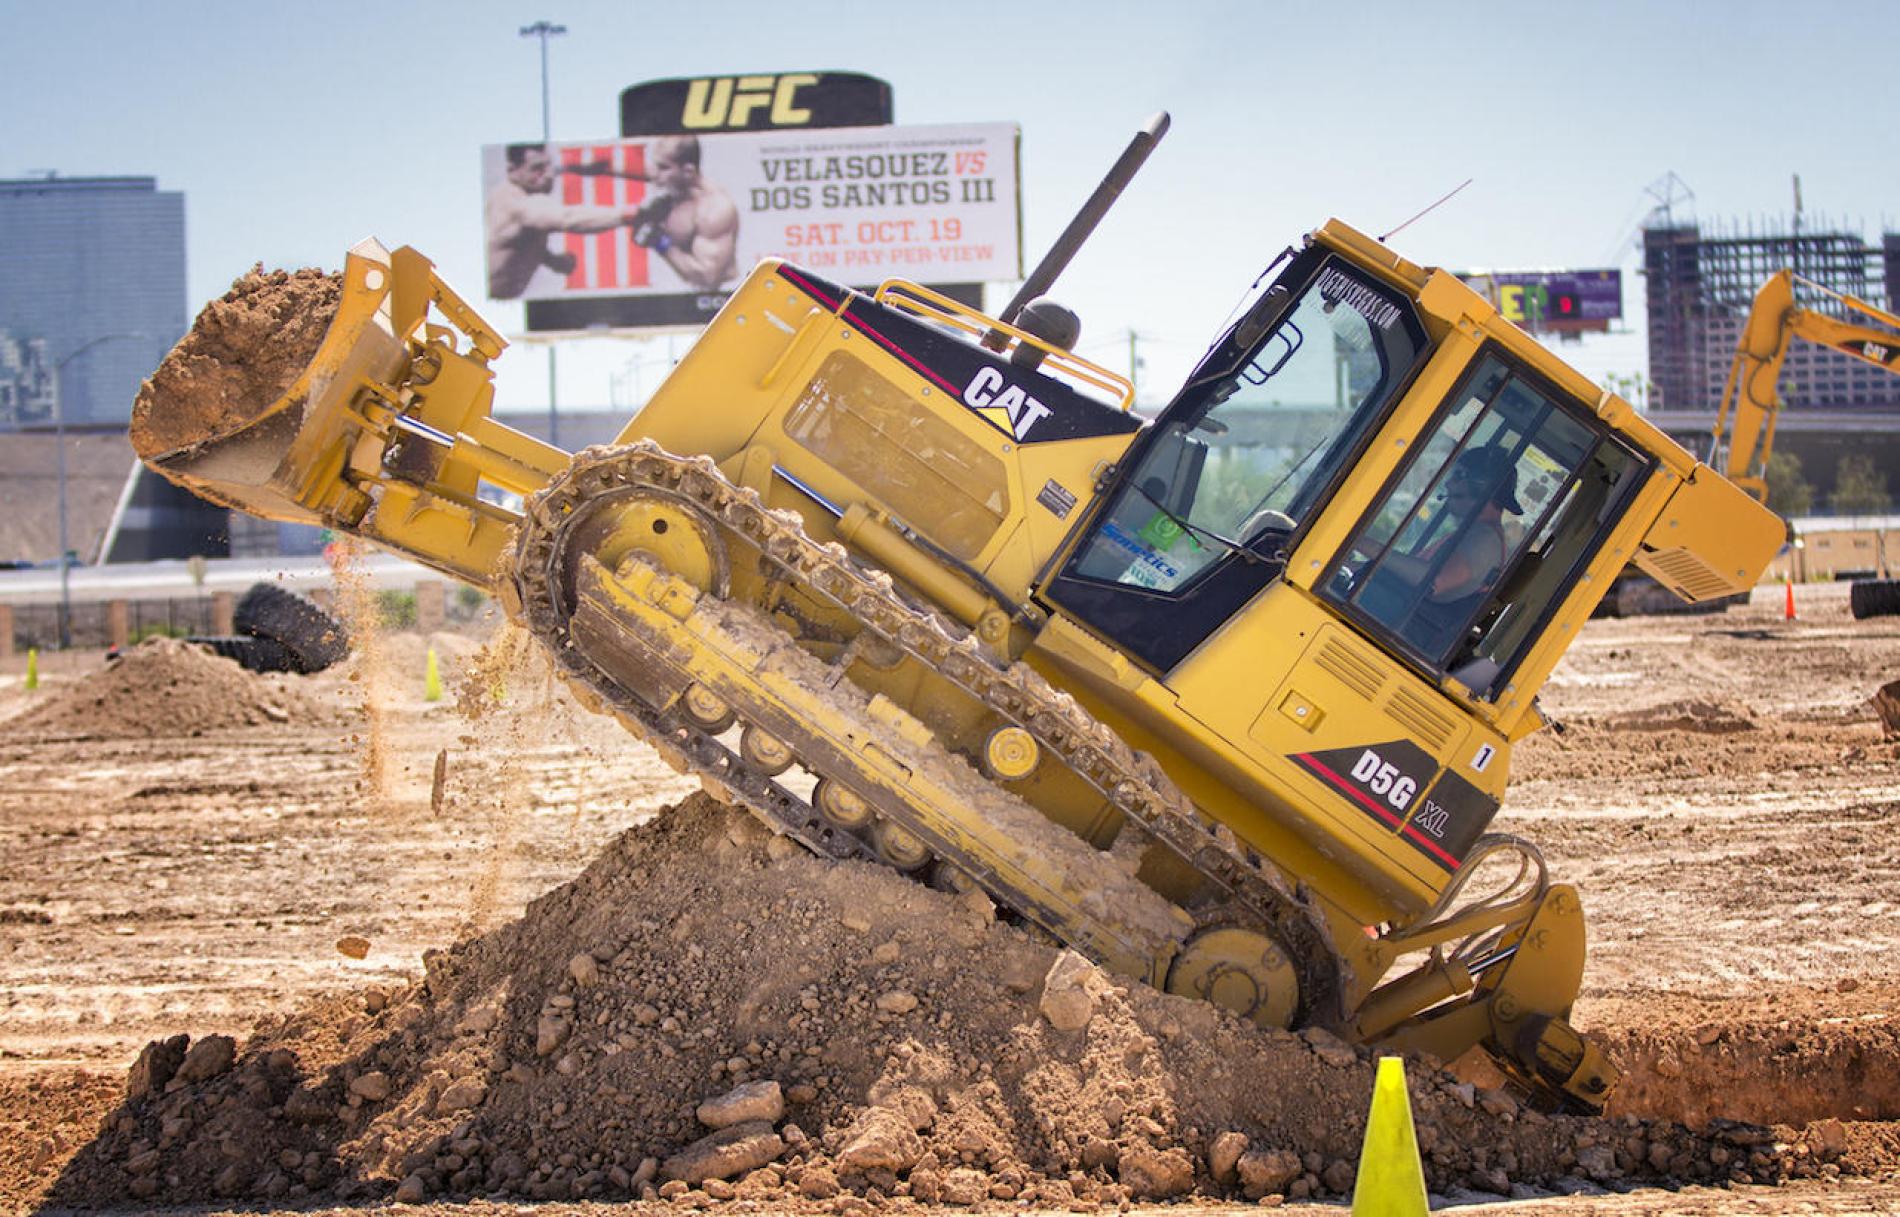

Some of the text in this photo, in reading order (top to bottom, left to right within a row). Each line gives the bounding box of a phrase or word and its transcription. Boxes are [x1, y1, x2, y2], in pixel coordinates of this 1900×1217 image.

[682, 74, 820, 129] UFC
[761, 150, 989, 183] VELASQUEZ VS
[749, 177, 997, 212] DOS SANTOS III
[784, 216, 963, 247] SAT. OCT. 19
[808, 249, 837, 269] ON
[1863, 341, 1889, 361] CAT
[963, 366, 1055, 442] CAT
[1476, 746, 1492, 769] 1
[1350, 749, 1418, 811] D5G
[1415, 799, 1451, 839] XL
